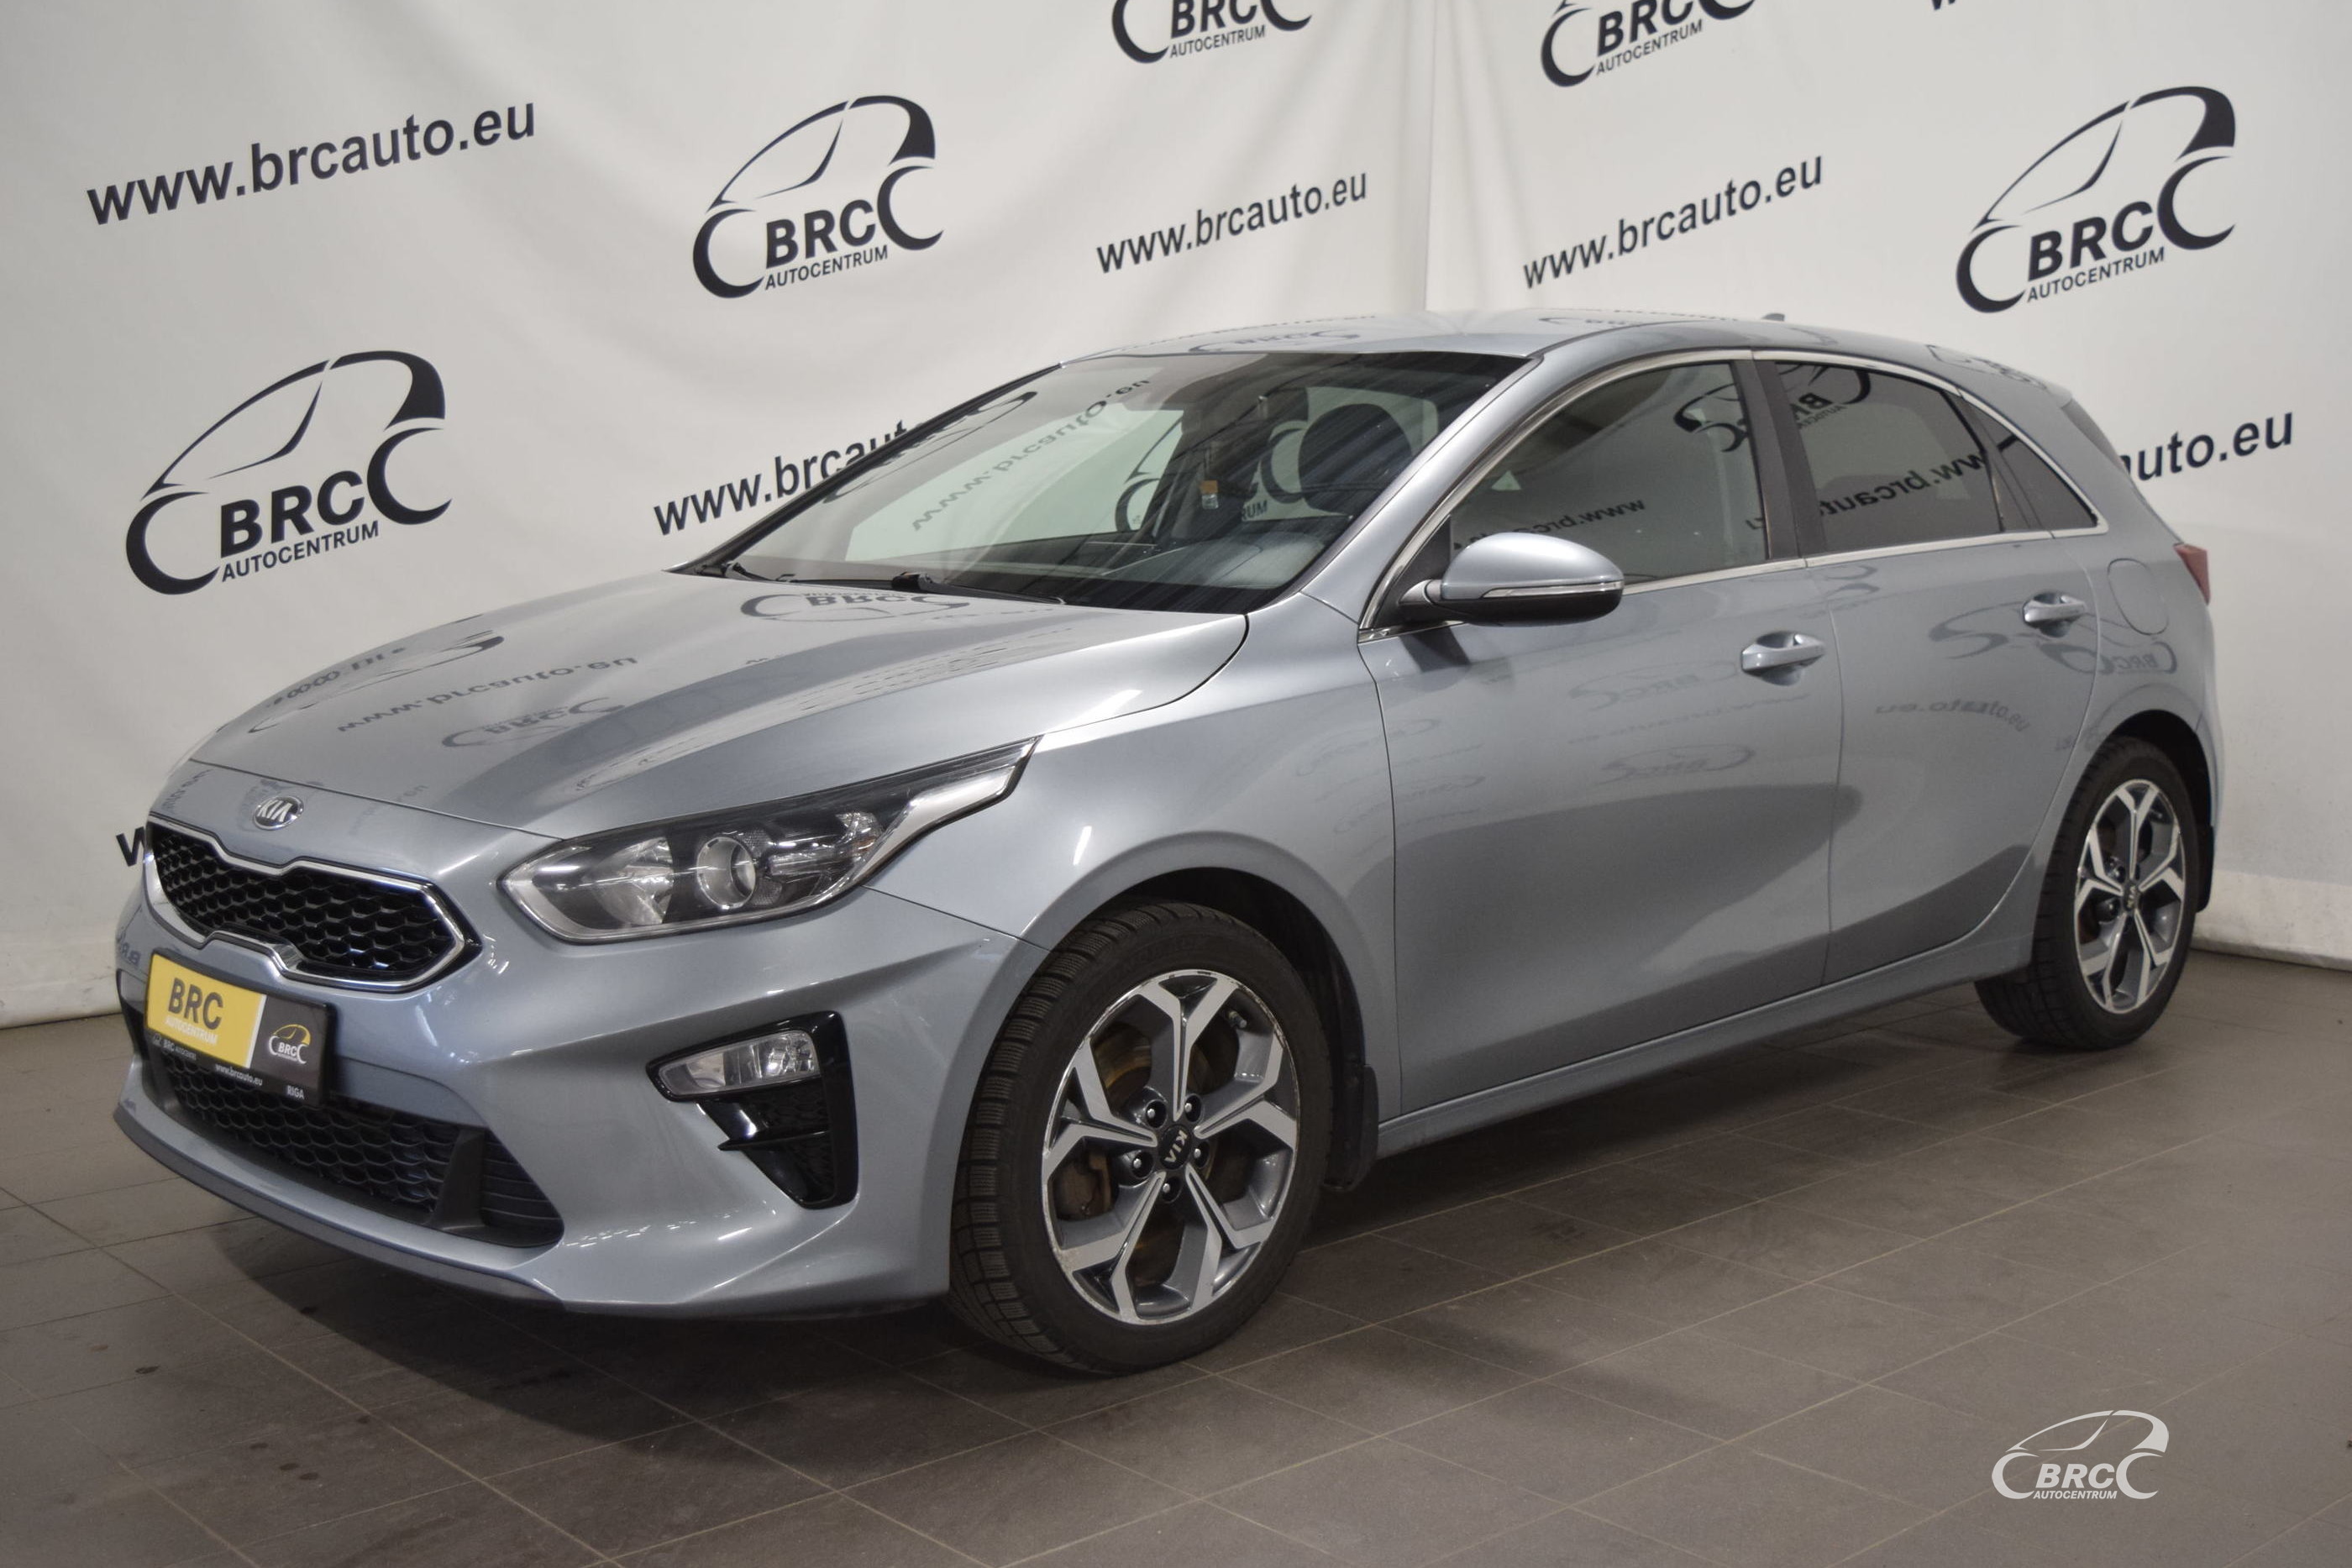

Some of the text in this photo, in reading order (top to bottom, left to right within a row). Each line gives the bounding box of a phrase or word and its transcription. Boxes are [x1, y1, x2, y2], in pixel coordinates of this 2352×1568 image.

[1170, 25, 1266, 59] AUTOCENTRUM
[1596, 18, 1703, 76] AUTOCENTRUM
[87, 102, 534, 225] www.brcauto.eu
[765, 199, 876, 268] BRC
[1097, 173, 1367, 273] www.brcauto.eu
[1523, 156, 1822, 289] www.brcauto.eu
[2027, 201, 2154, 281] BRC
[765, 245, 889, 291] AUTOCENTRUM
[2027, 246, 2166, 303] AUTOCENTRUM
[220, 470, 365, 558] BRC
[222, 521, 379, 583] AUTOCENTRUM
[256, 800, 293, 822] KIA
[168, 978, 223, 1030] BRC
[215, 1063, 263, 1086] www.brcauto.eu
[286, 1085, 305, 1100] RIGA
